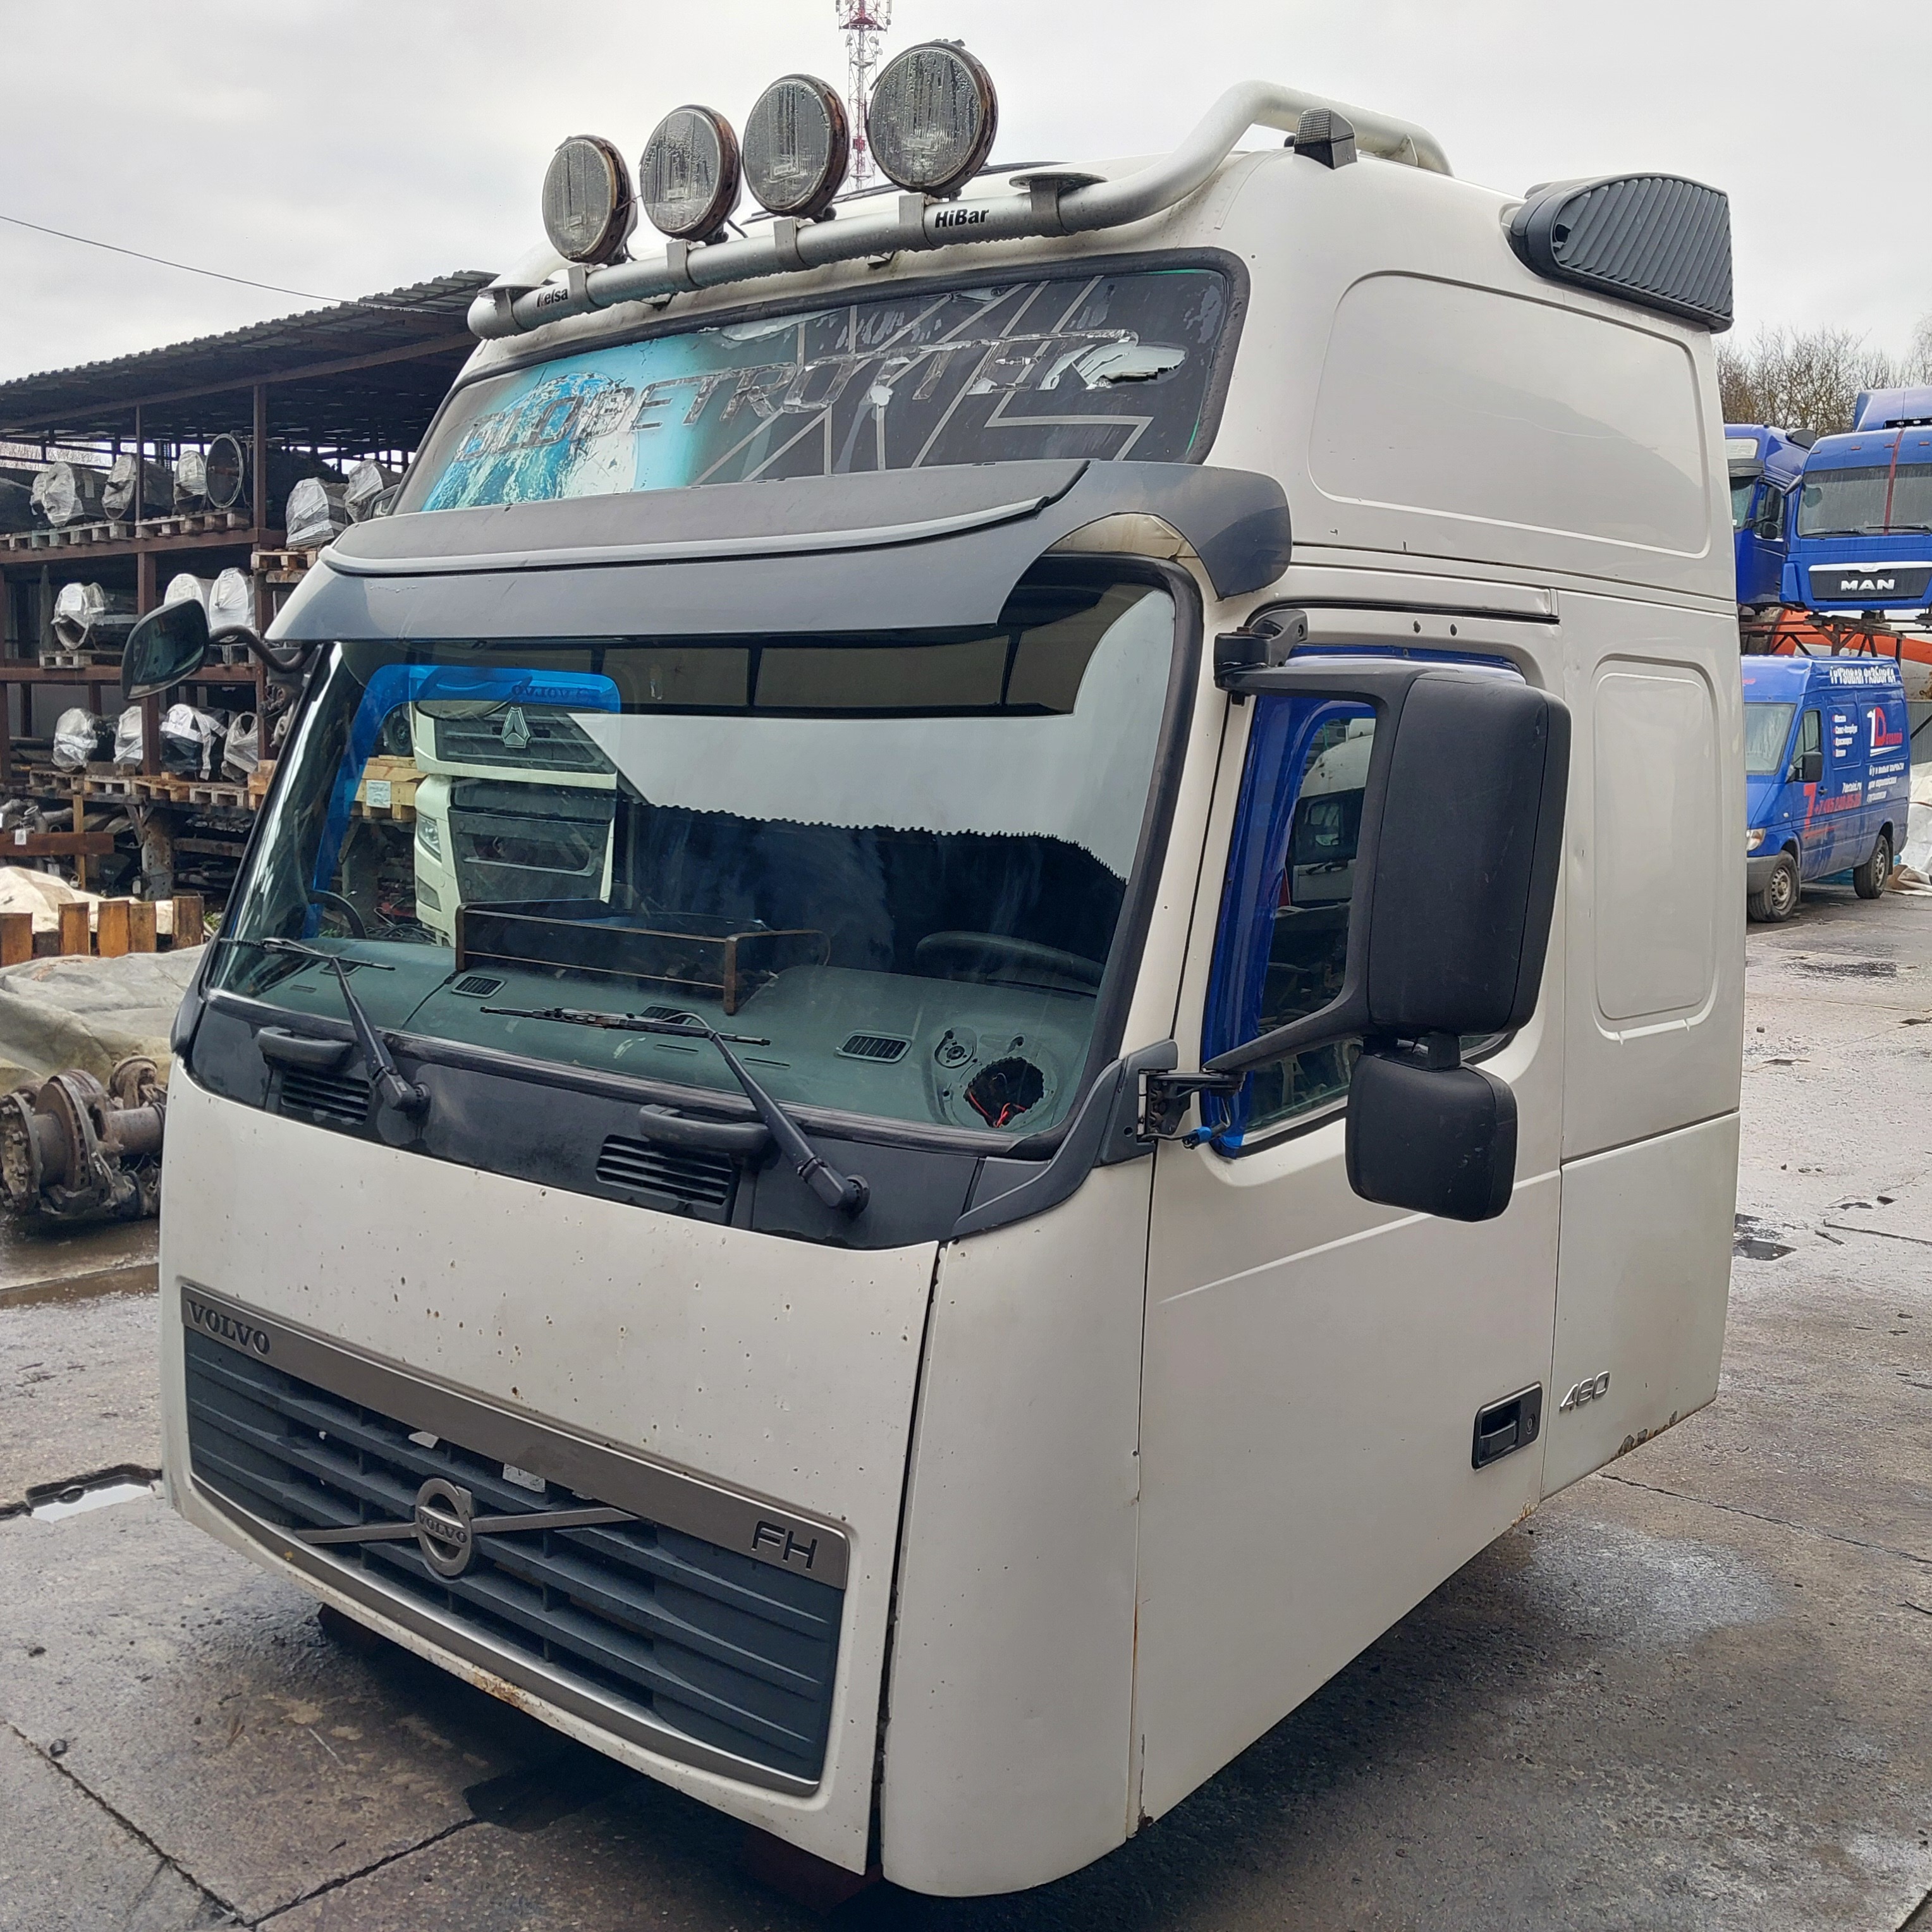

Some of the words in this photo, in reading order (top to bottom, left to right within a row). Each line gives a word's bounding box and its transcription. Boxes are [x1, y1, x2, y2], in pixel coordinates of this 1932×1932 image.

[935, 209, 989, 228] HiBar
[1840, 578, 1895, 591] MAN
[186, 1299, 271, 1355] VOLVO
[1559, 1371, 1610, 1412] 460
[418, 1513, 468, 1543] VOLVO
[751, 1520, 818, 1571] FH
